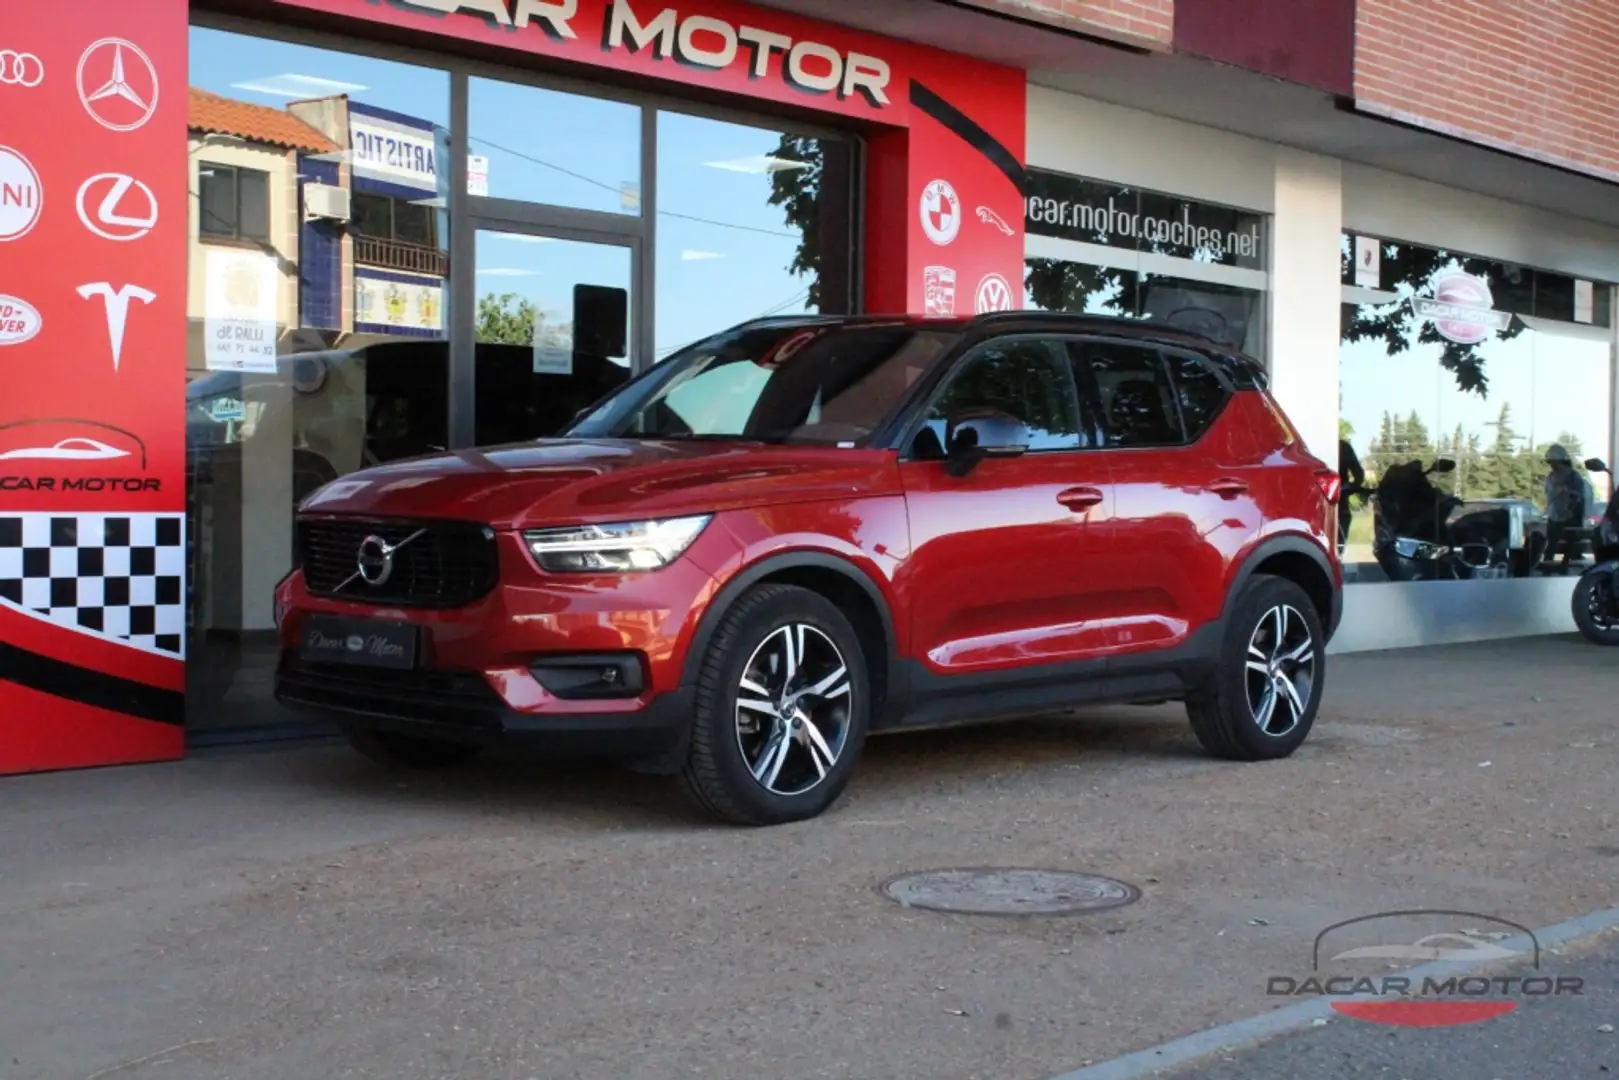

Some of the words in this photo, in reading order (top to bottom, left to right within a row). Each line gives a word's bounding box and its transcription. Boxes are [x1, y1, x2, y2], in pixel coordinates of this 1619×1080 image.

[608, 0, 891, 104] MOTOR
[1024, 195, 1260, 258] car.motor.coches.net
[61, 477, 161, 492] MOTOR
